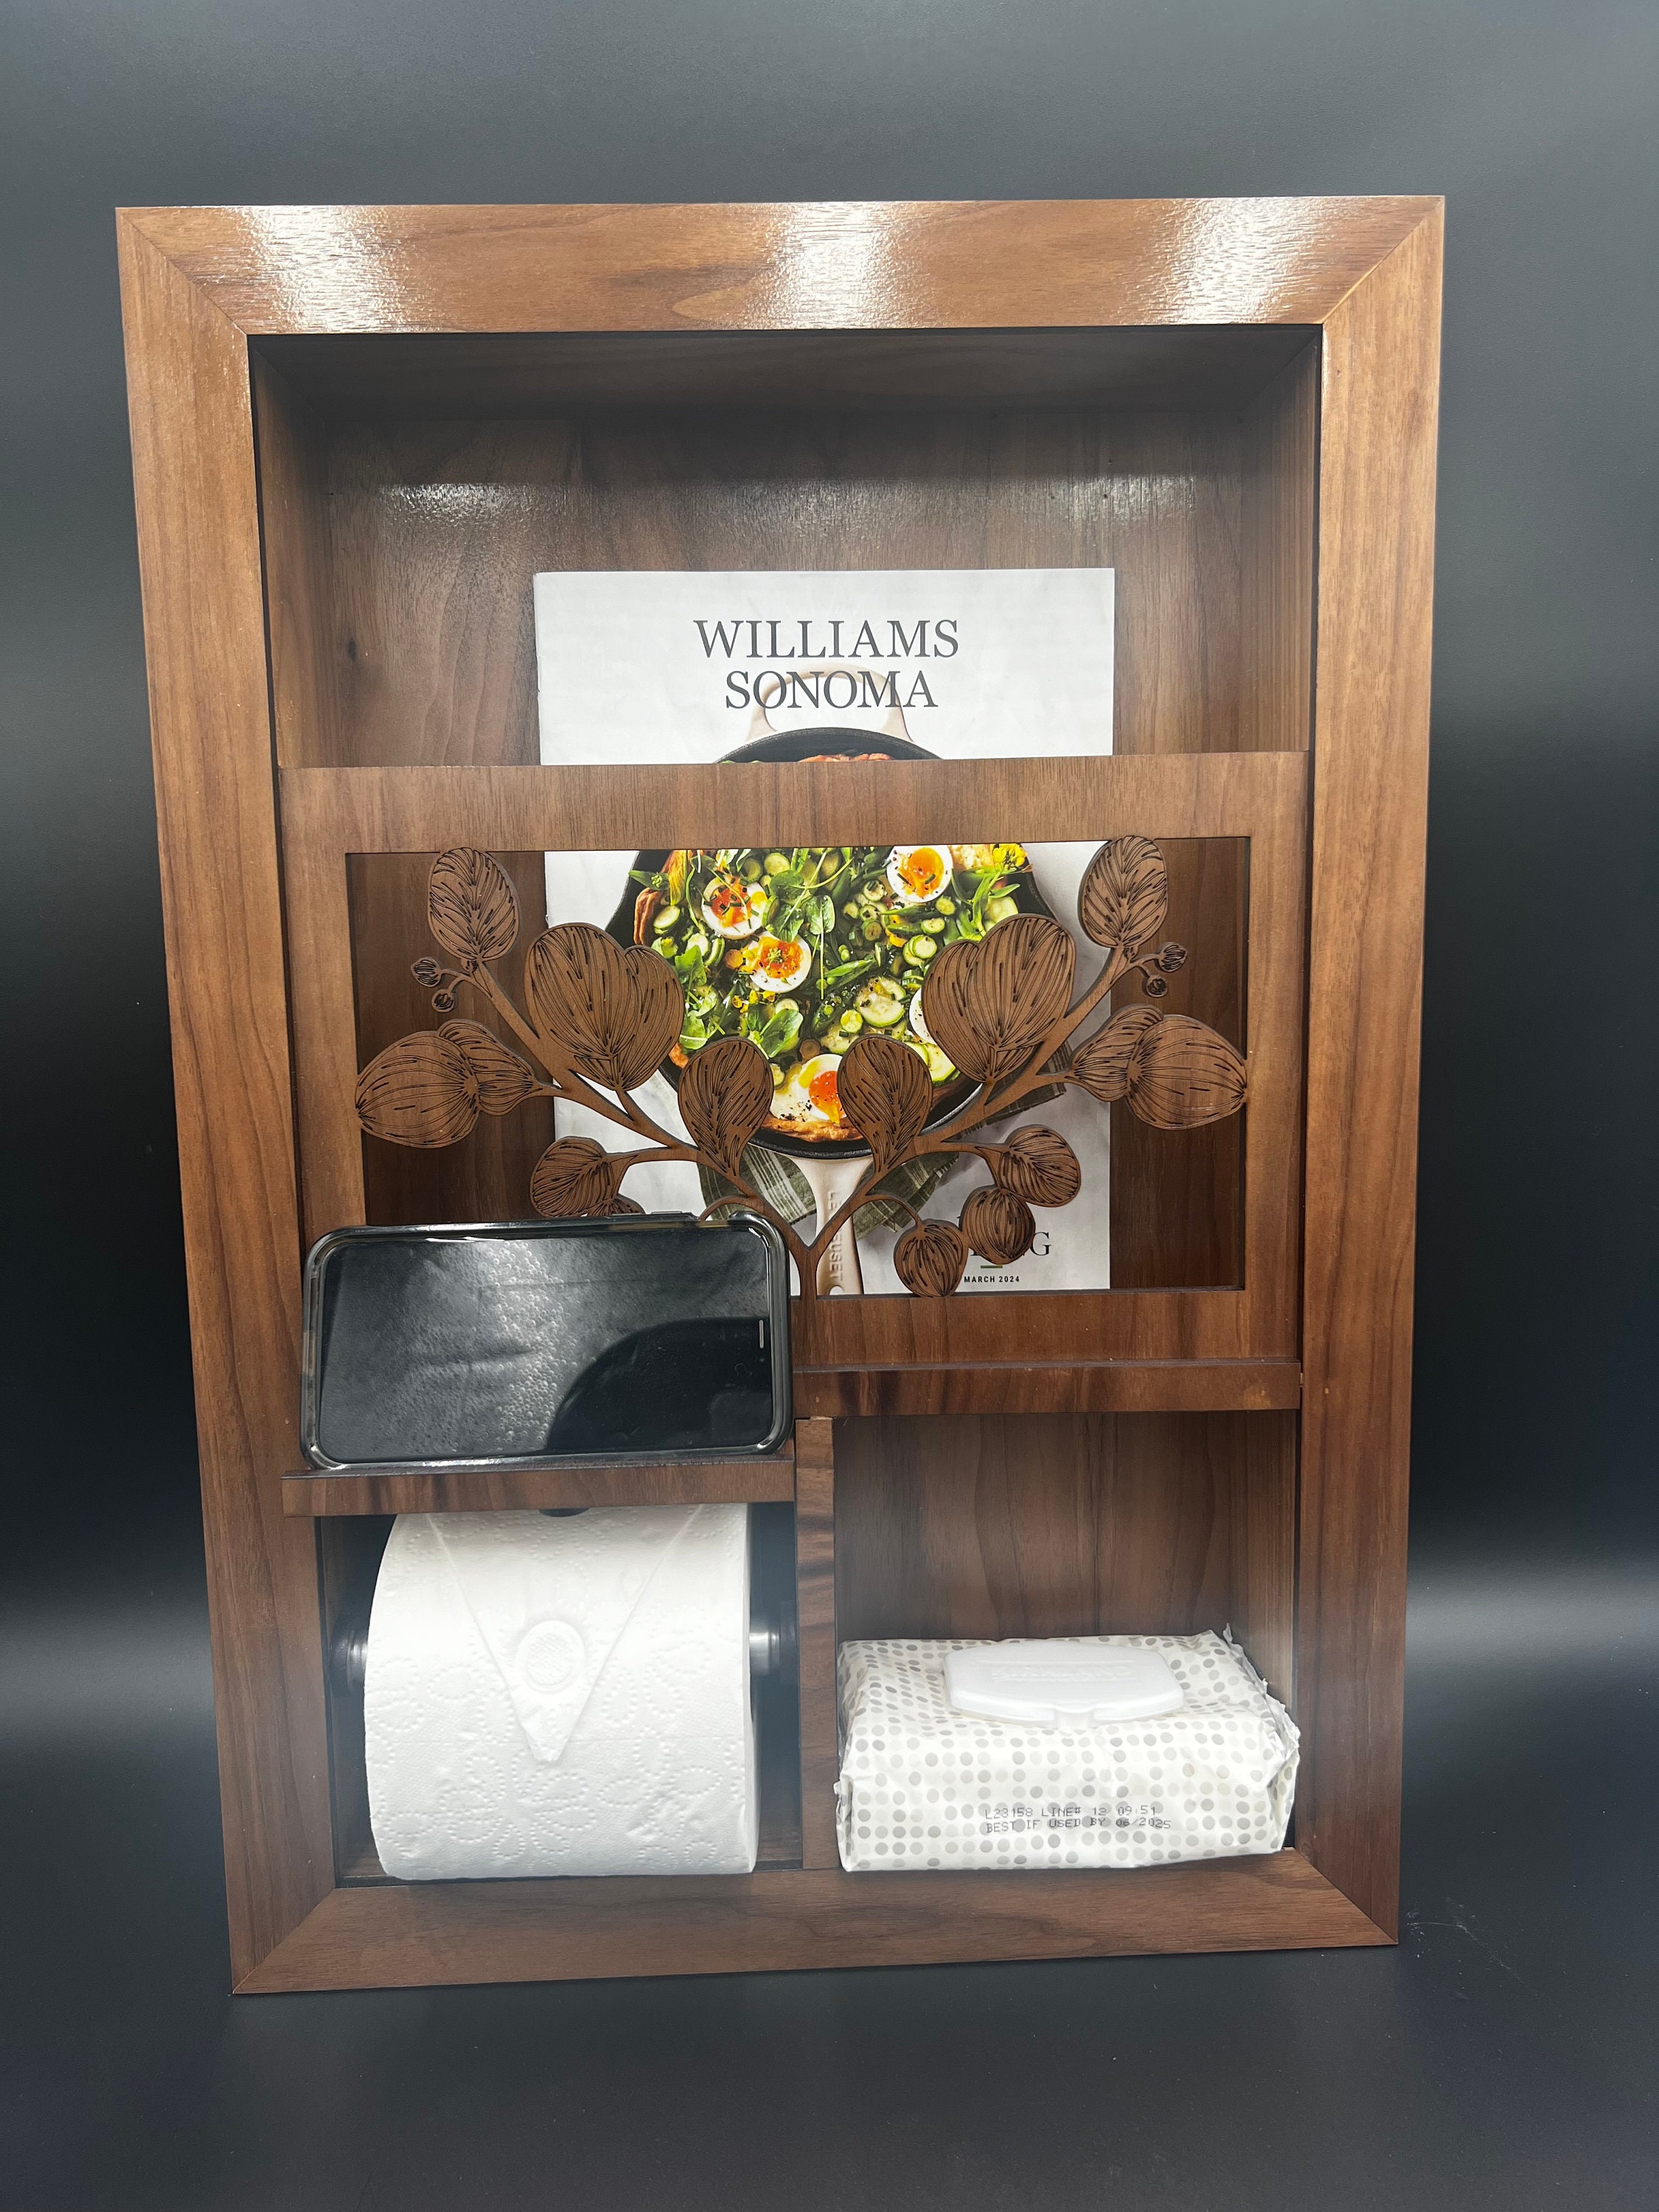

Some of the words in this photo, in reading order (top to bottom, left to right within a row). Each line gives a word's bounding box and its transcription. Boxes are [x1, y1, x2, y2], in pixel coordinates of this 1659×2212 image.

[693, 619, 959, 658] WILLIAMS
[726, 670, 939, 709] SONOMA
[985, 1807, 1033, 1819] L23158
[1041, 1806, 1081, 1817] LINE#
[1092, 1806, 1107, 1815] 12
[1118, 1804, 1156, 1815] 09:51
[986, 1820, 1017, 1833] BEST
[1026, 1819, 1041, 1829] IF
[1048, 1818, 1081, 1828] USED
[1091, 1817, 1106, 1826] BY
[1116, 1817, 1172, 1829] 06/2025
